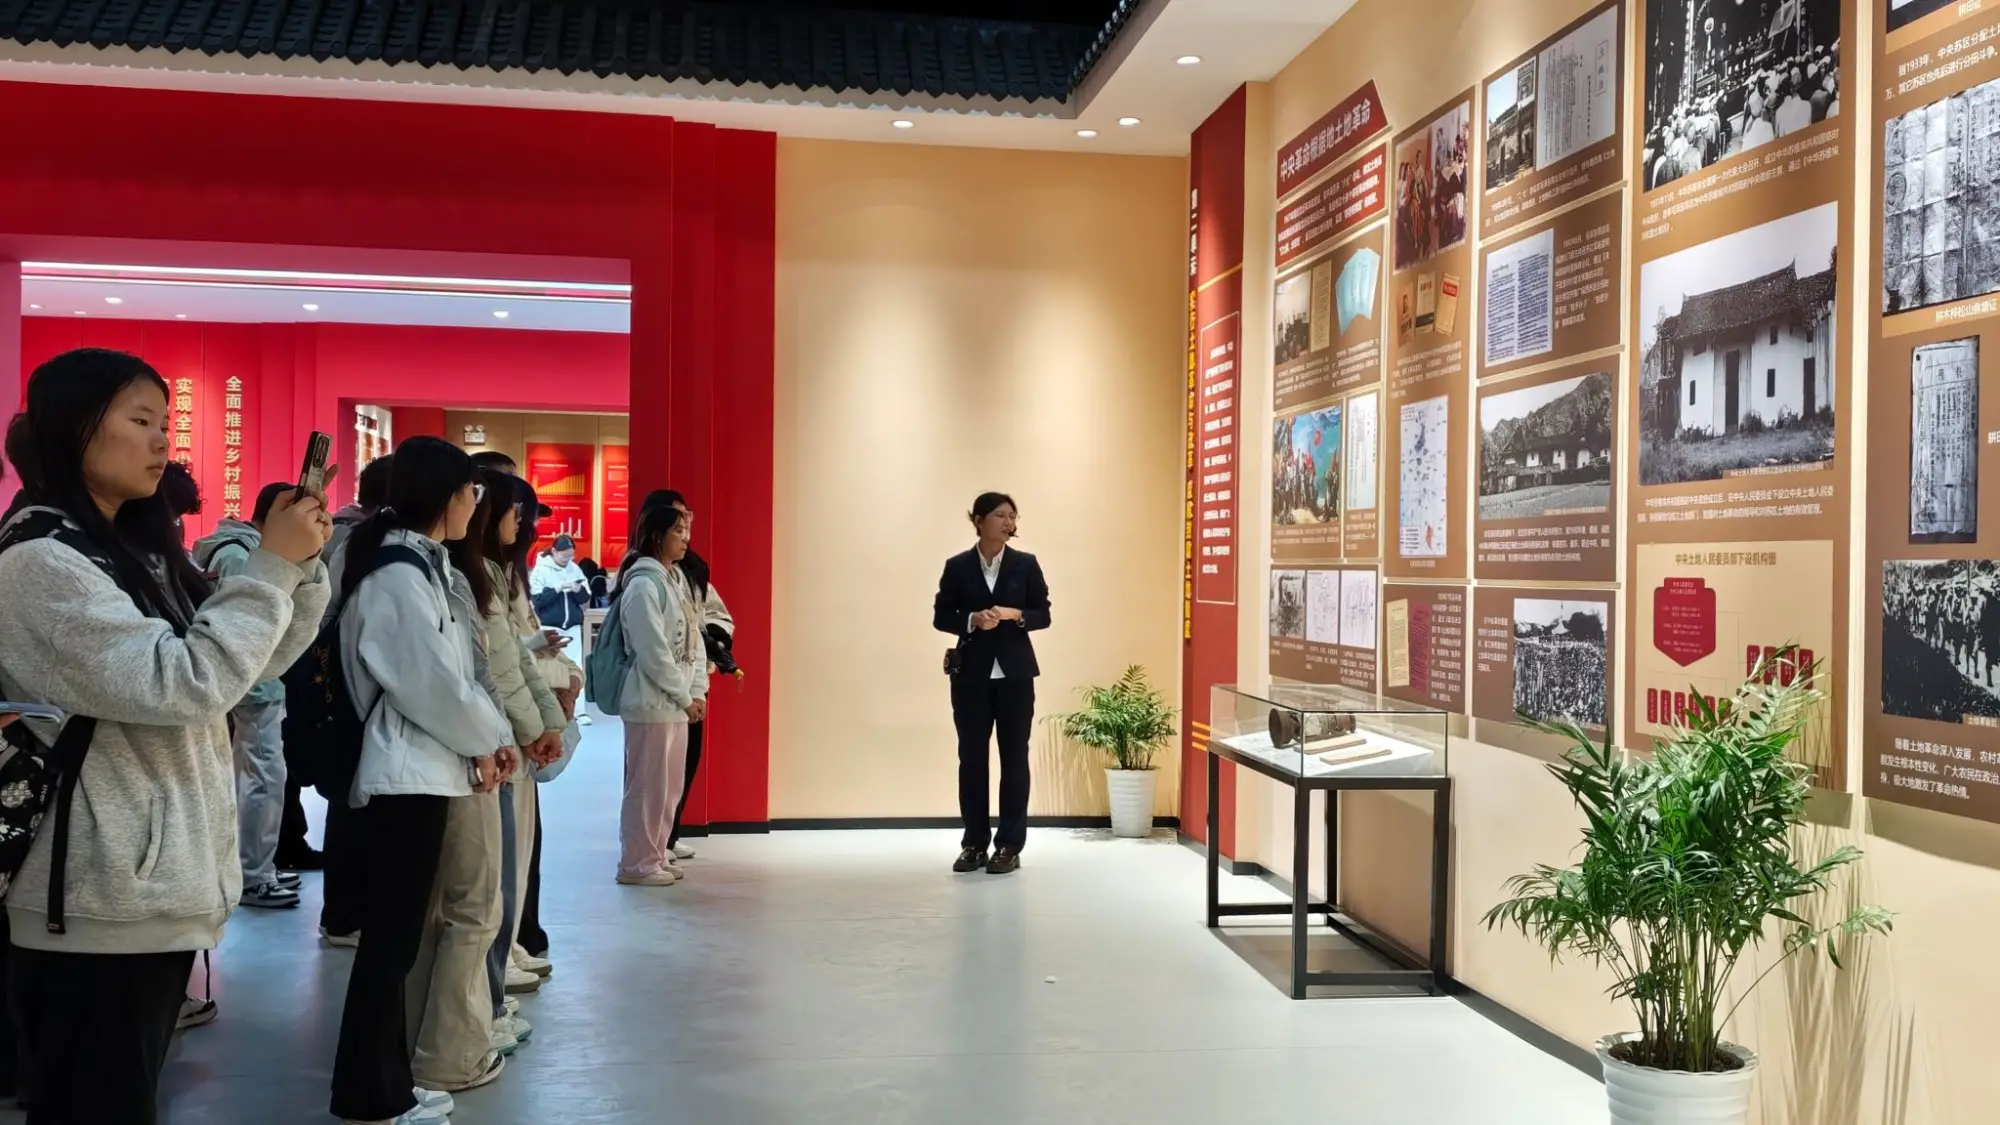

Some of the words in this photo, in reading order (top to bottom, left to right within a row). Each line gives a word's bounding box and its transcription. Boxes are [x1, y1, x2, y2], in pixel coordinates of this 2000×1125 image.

[1280, 97, 1371, 182] 中央革命根据地土地革命
[223, 375, 242, 519] 全面推进乡村振兴
[1675, 551, 1777, 566] 中央土地人民委员部下设机构图
